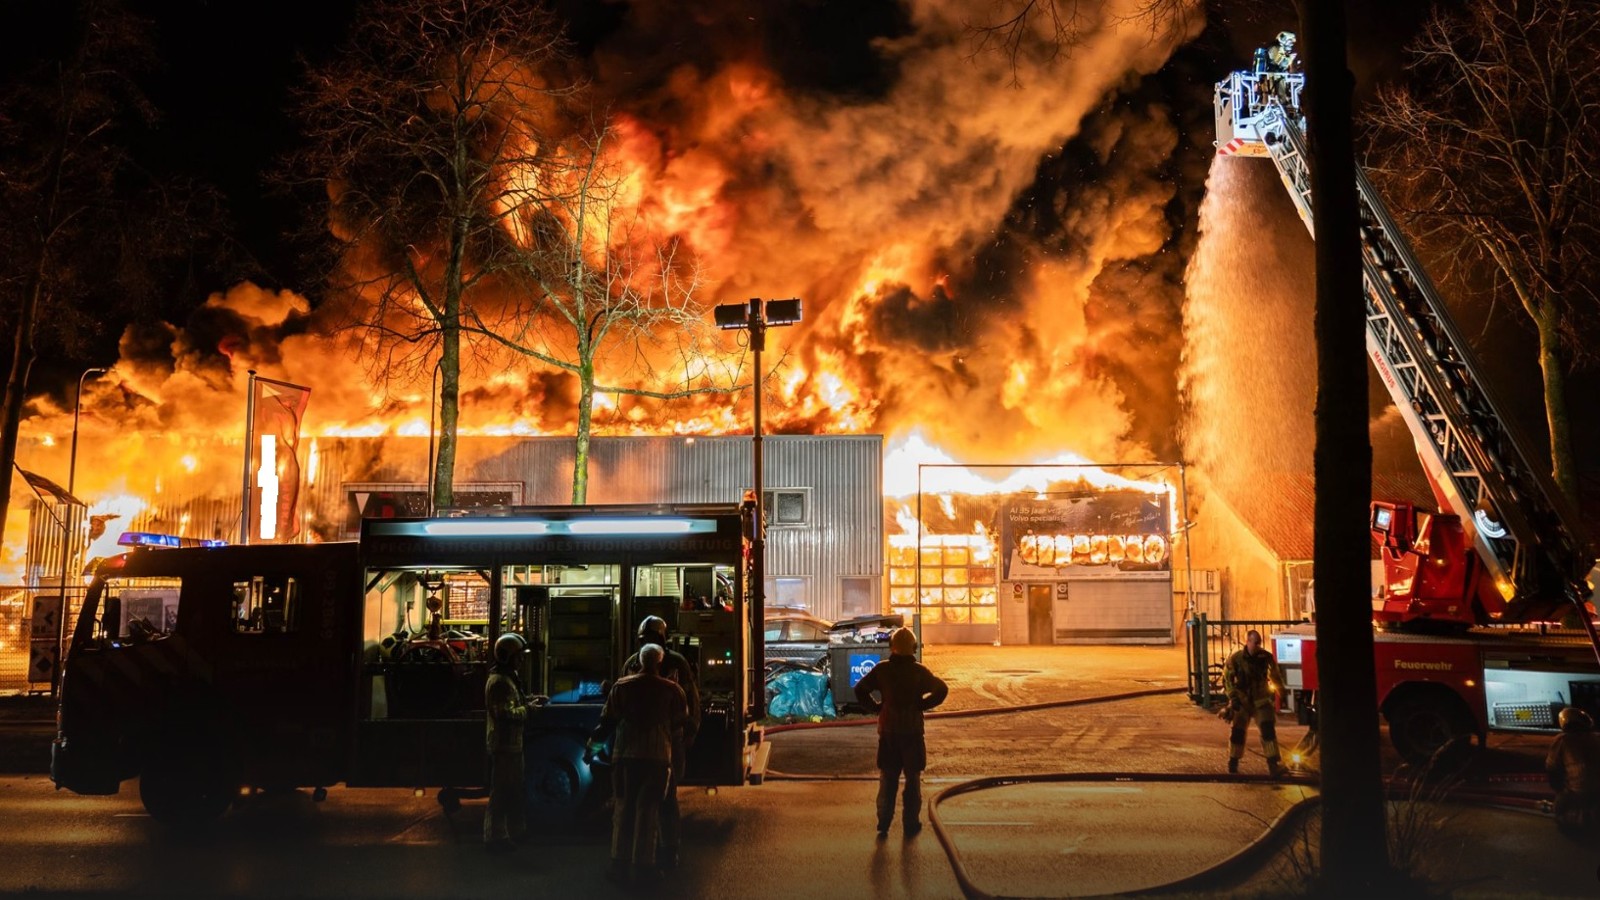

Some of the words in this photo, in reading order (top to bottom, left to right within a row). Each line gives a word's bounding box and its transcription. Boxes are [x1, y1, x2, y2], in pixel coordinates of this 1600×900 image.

[1373, 350, 1396, 388] MAGIRUS
[371, 541, 490, 553] SPECIALISTISCH
[658, 539, 733, 551] VOERTUIG
[1394, 659, 1453, 671] Feuerwehr
